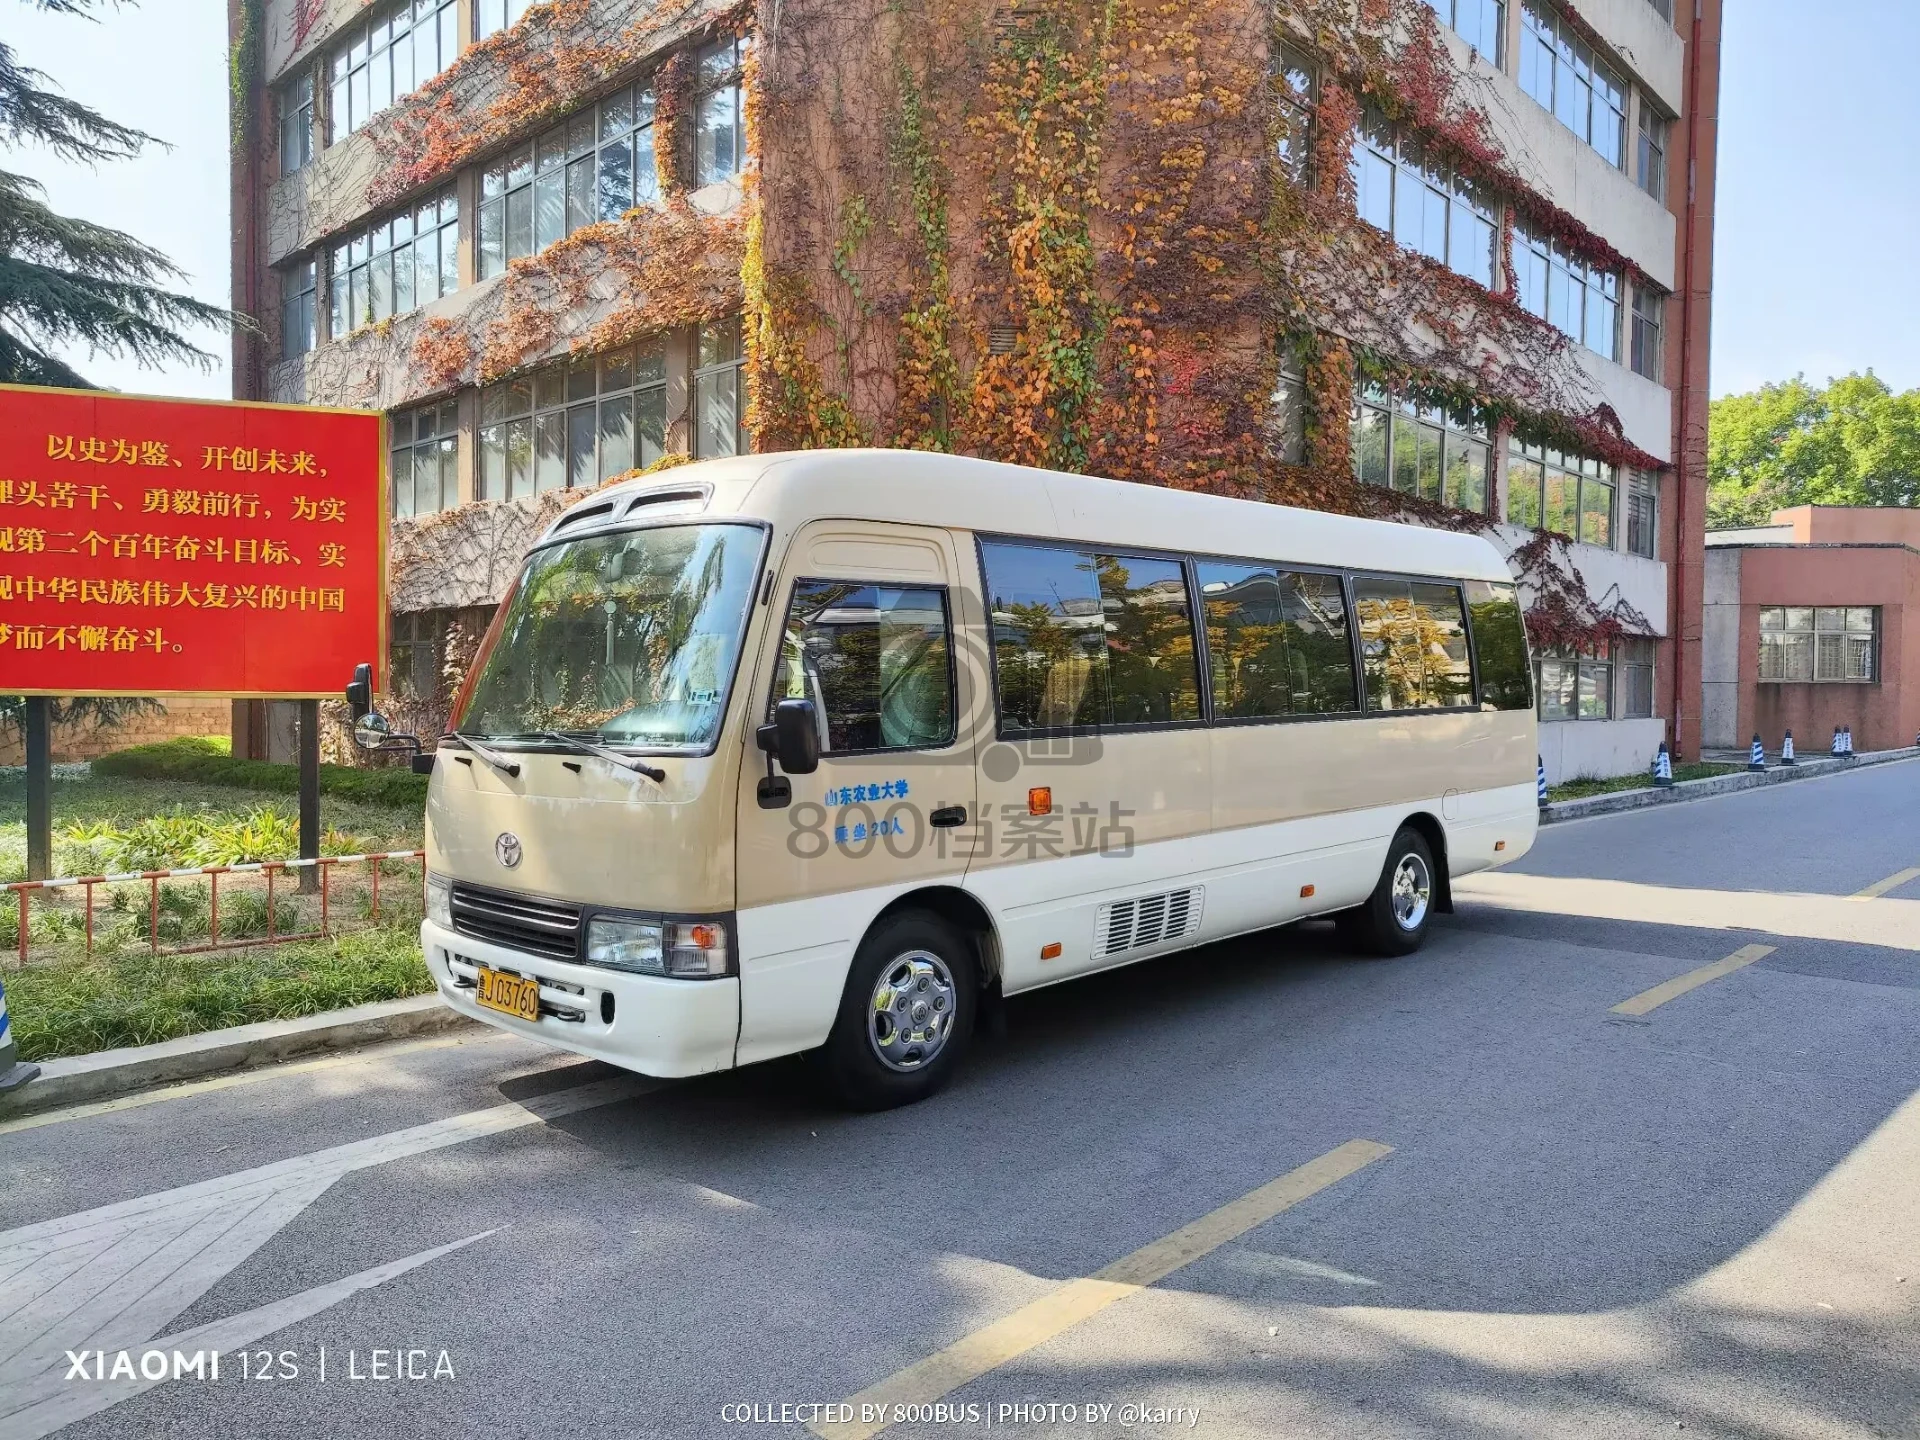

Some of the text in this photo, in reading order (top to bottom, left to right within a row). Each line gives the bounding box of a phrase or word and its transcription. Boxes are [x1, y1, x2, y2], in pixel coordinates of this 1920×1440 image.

[47, 434, 328, 478] 以史为鉴、开创未来，
[825, 779, 909, 806] 山东农业大学
